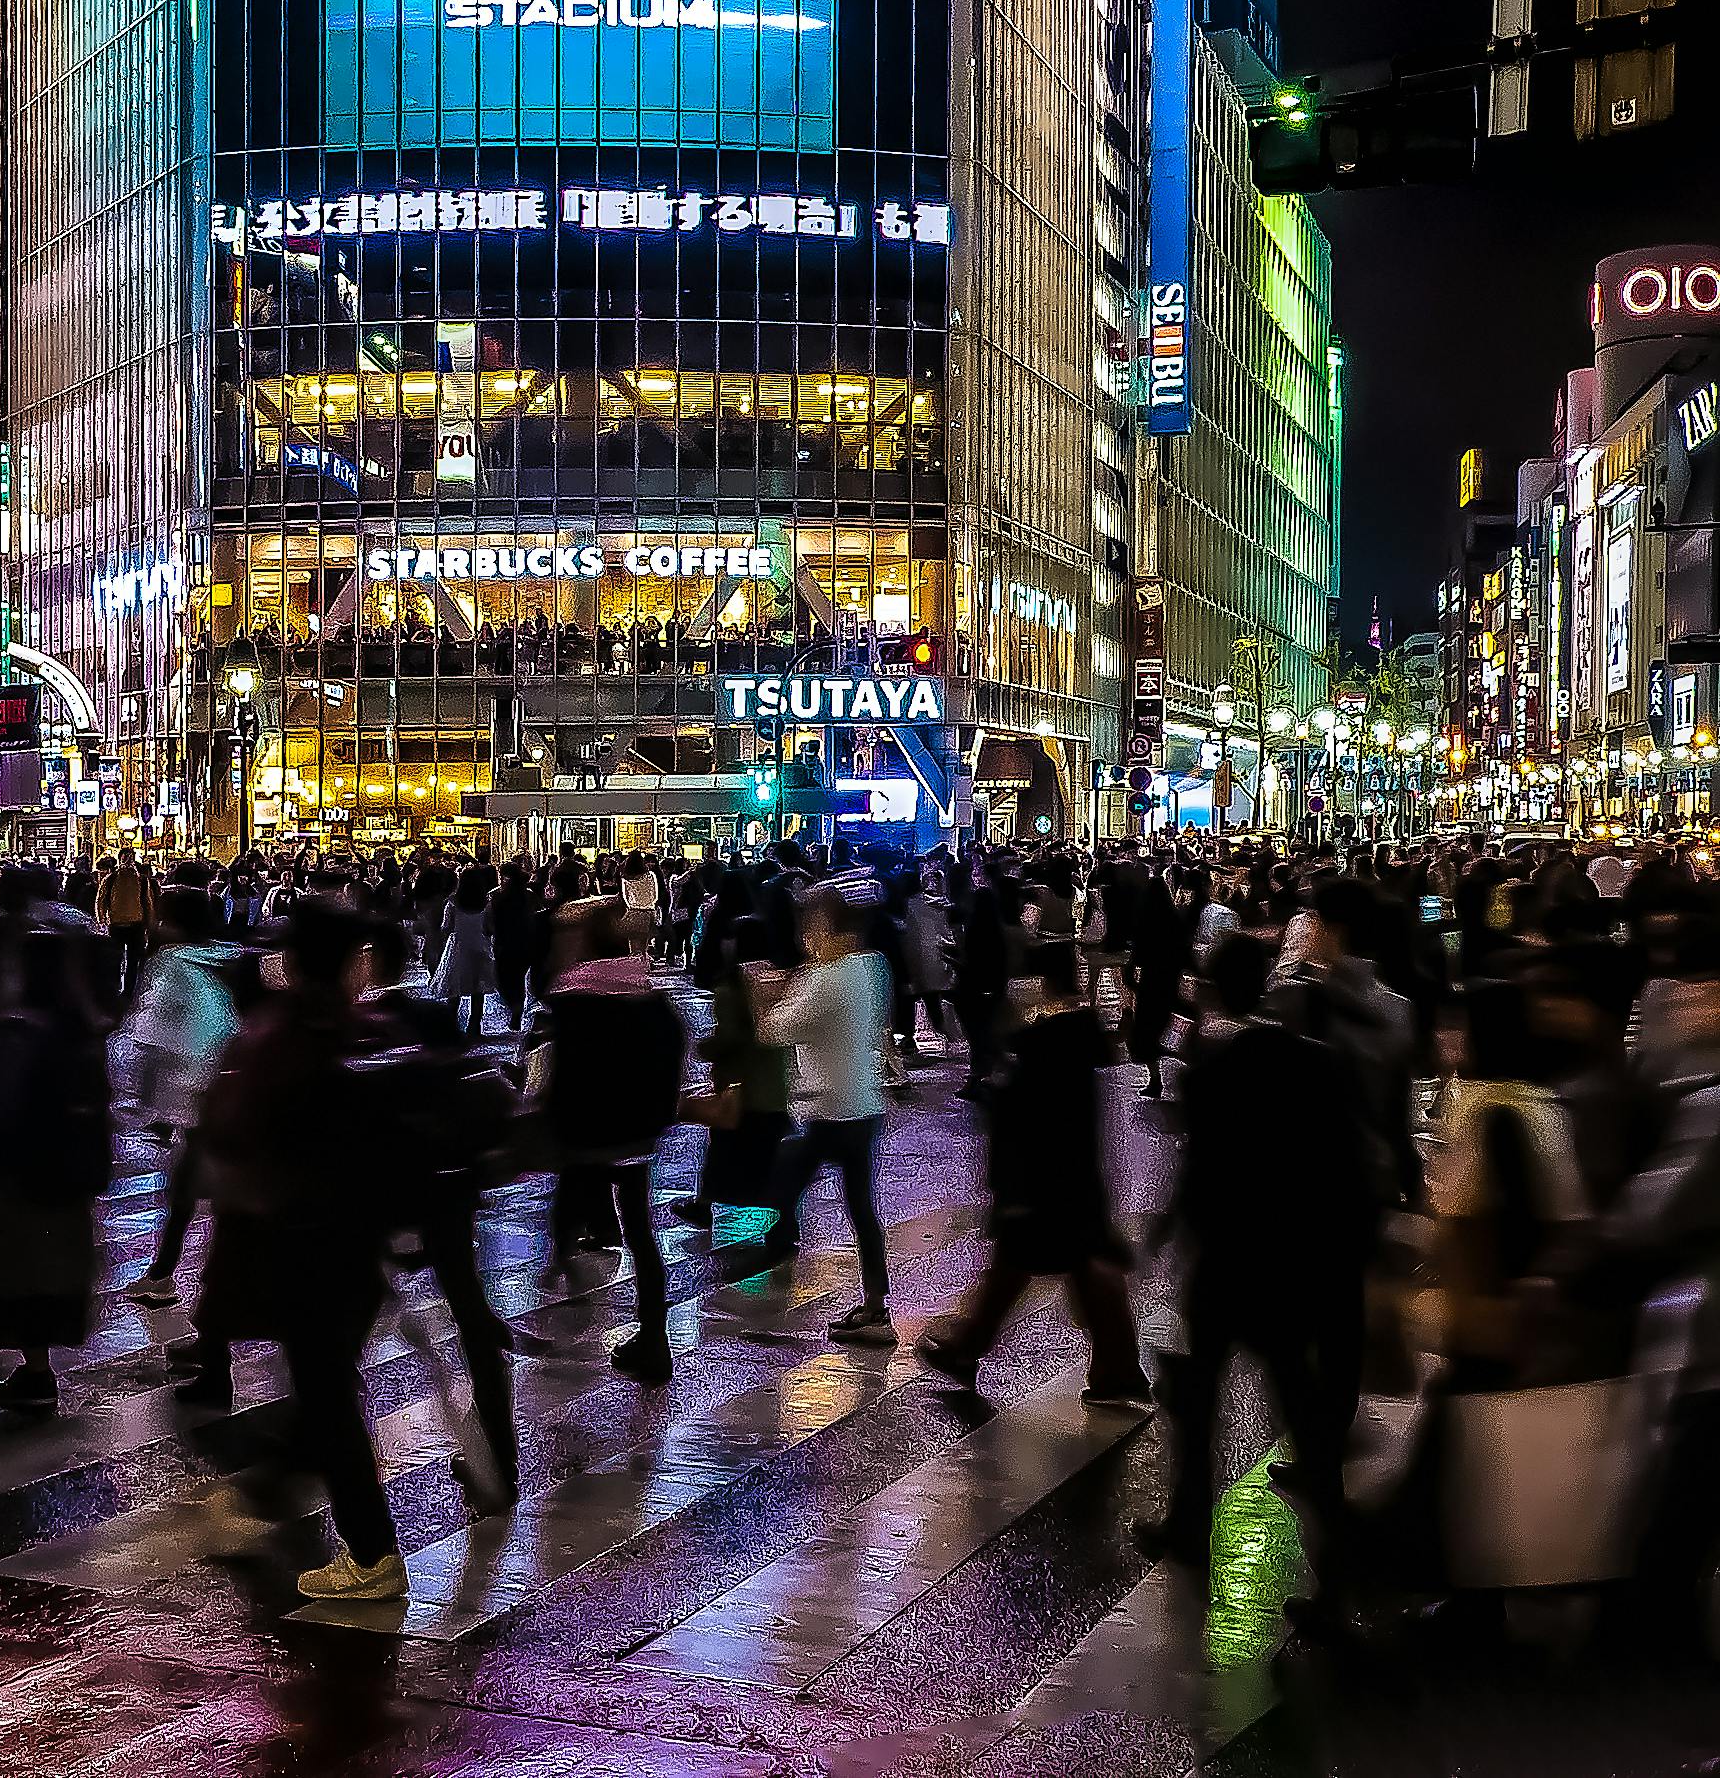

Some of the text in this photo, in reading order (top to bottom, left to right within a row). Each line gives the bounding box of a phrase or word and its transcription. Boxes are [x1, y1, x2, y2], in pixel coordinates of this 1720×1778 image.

[368, 546, 773, 580] STARBUCKS COFFEE
[724, 678, 940, 720] TSUTAYA
[1650, 669, 1664, 717] ZARA
